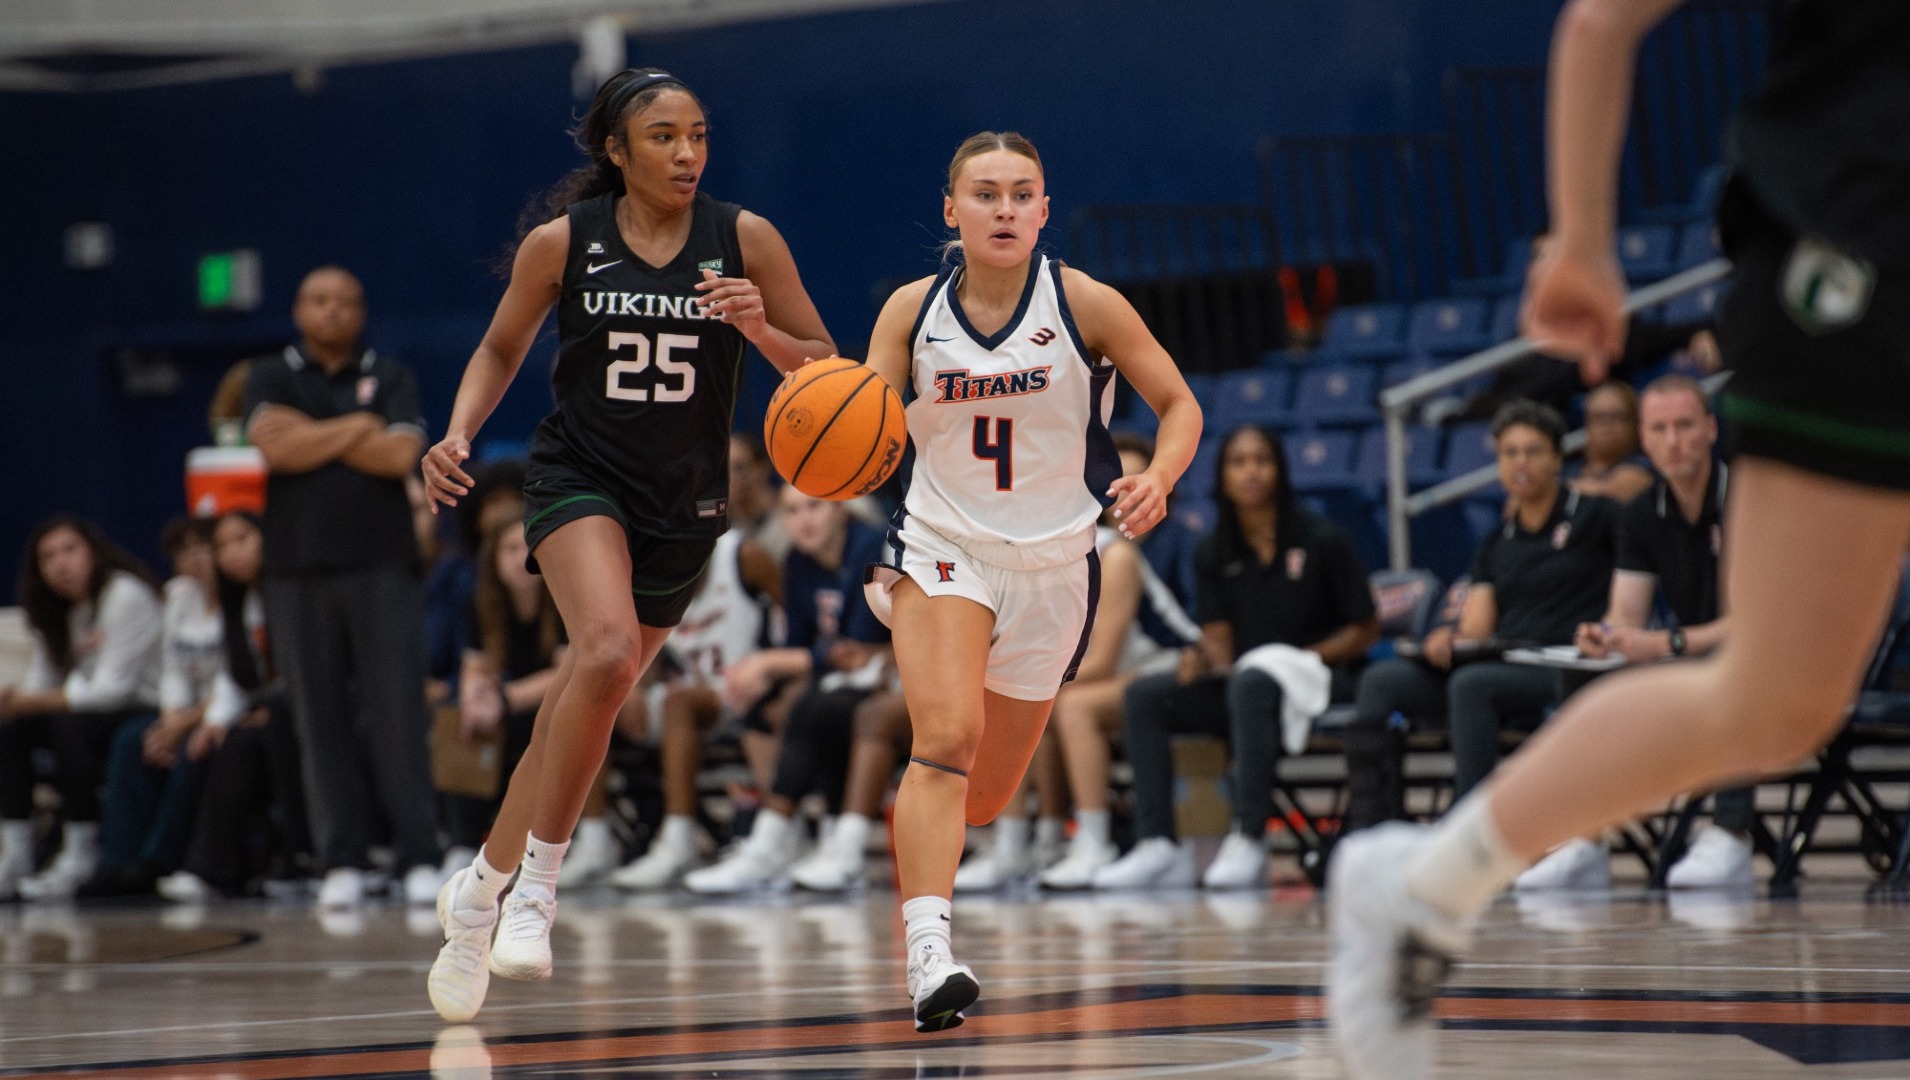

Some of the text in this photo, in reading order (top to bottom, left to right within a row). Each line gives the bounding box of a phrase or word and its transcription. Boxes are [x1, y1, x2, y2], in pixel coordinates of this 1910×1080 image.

[606, 331, 699, 402] 25
[935, 366, 1050, 402] TITANS
[853, 435, 900, 495] NCAA
[972, 415, 1013, 491] 4
